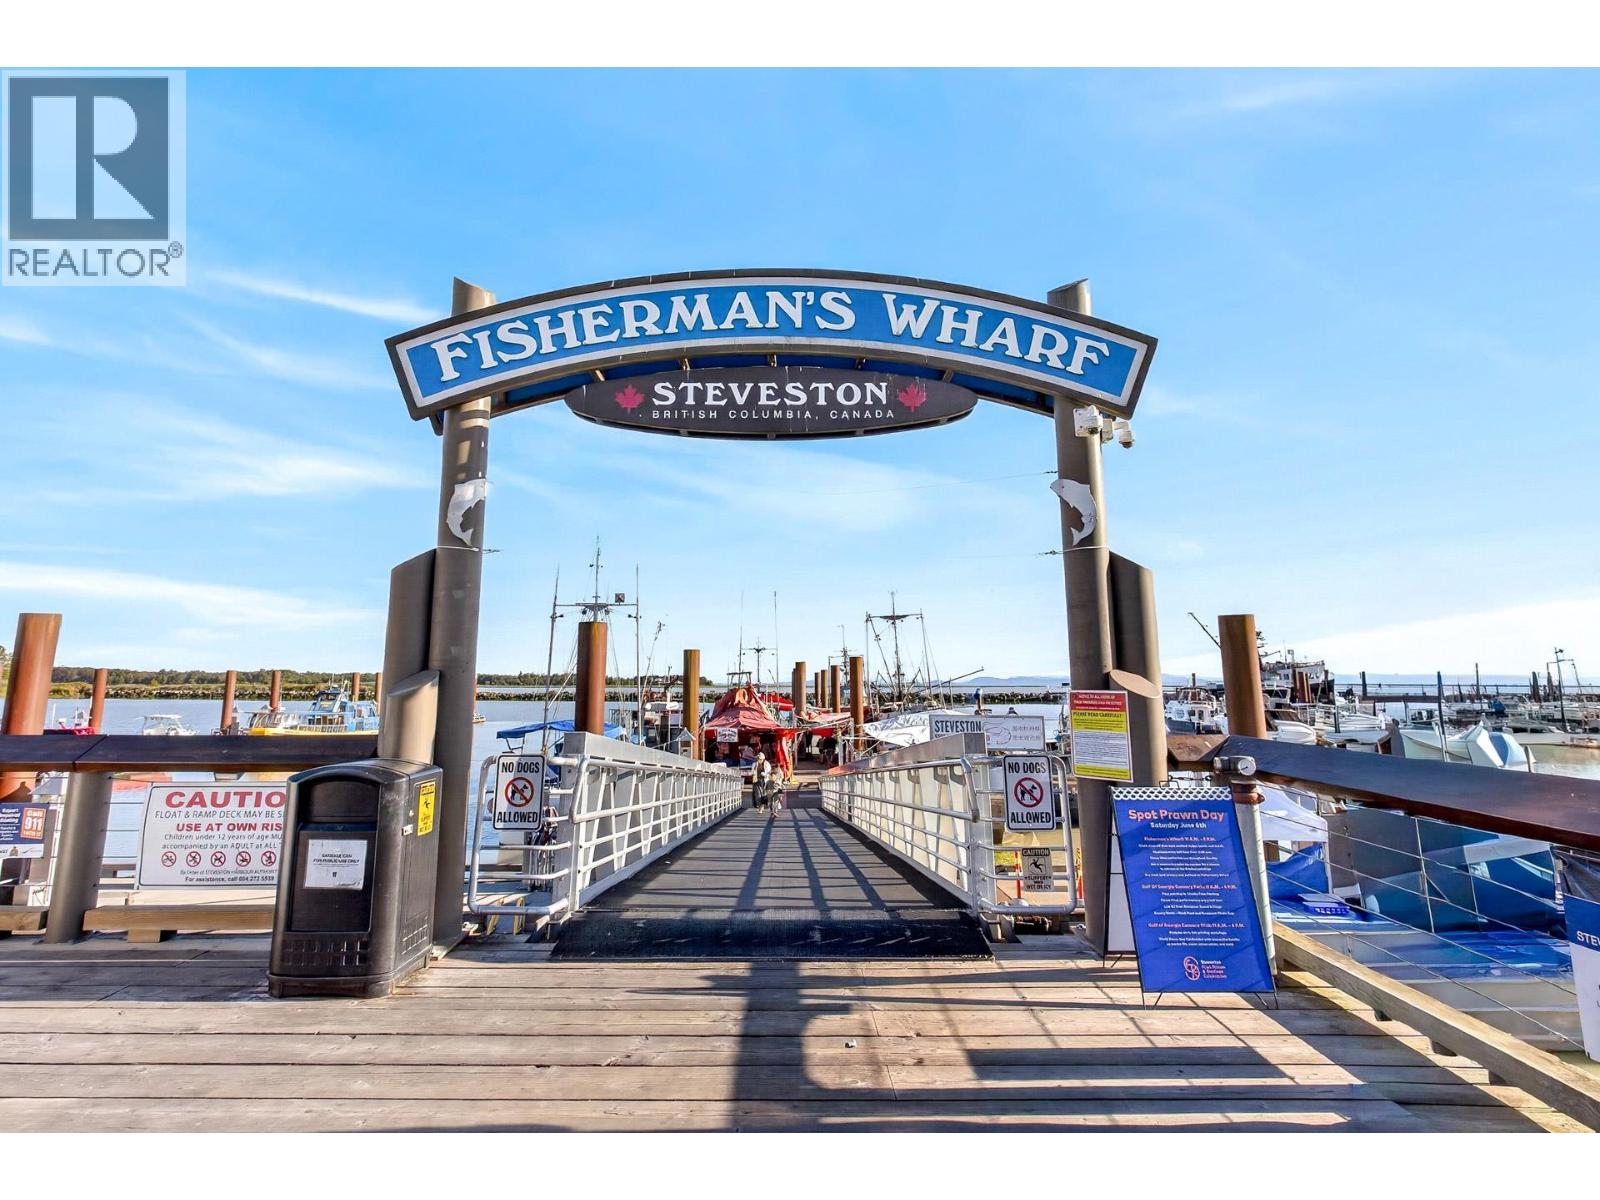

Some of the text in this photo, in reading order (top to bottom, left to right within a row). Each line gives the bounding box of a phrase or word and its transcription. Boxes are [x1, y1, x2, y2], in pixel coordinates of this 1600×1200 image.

[430, 291, 1110, 382] FISHERMAN'S WHARF
[652, 382, 889, 406] STEVESTON
[652, 409, 895, 421] BRITISH COLUMBIA, CANADA
[934, 720, 982, 733] STEVESTON
[501, 761, 540, 774] NO DOGS
[1008, 761, 1046, 774] NO DOGS
[165, 791, 286, 808] CAUTIO
[155, 811, 182, 819] FLOAT
[184, 811, 191, 819] &
[192, 811, 217, 819] RAMP
[219, 811, 242, 819] DECK
[243, 811, 263, 819] MAY
[265, 811, 276, 819] BE
[497, 811, 538, 823] ALLOWED
[1011, 812, 1052, 824] ALLOWED
[1128, 809, 1225, 823] Spot Prawn Day
[25, 816, 43, 831] 911
[176, 823, 283, 832] USE AT OWN RIS
[1150, 822, 1179, 830] Saturday
[164, 833, 194, 841] Children
[228, 834, 246, 842] years
